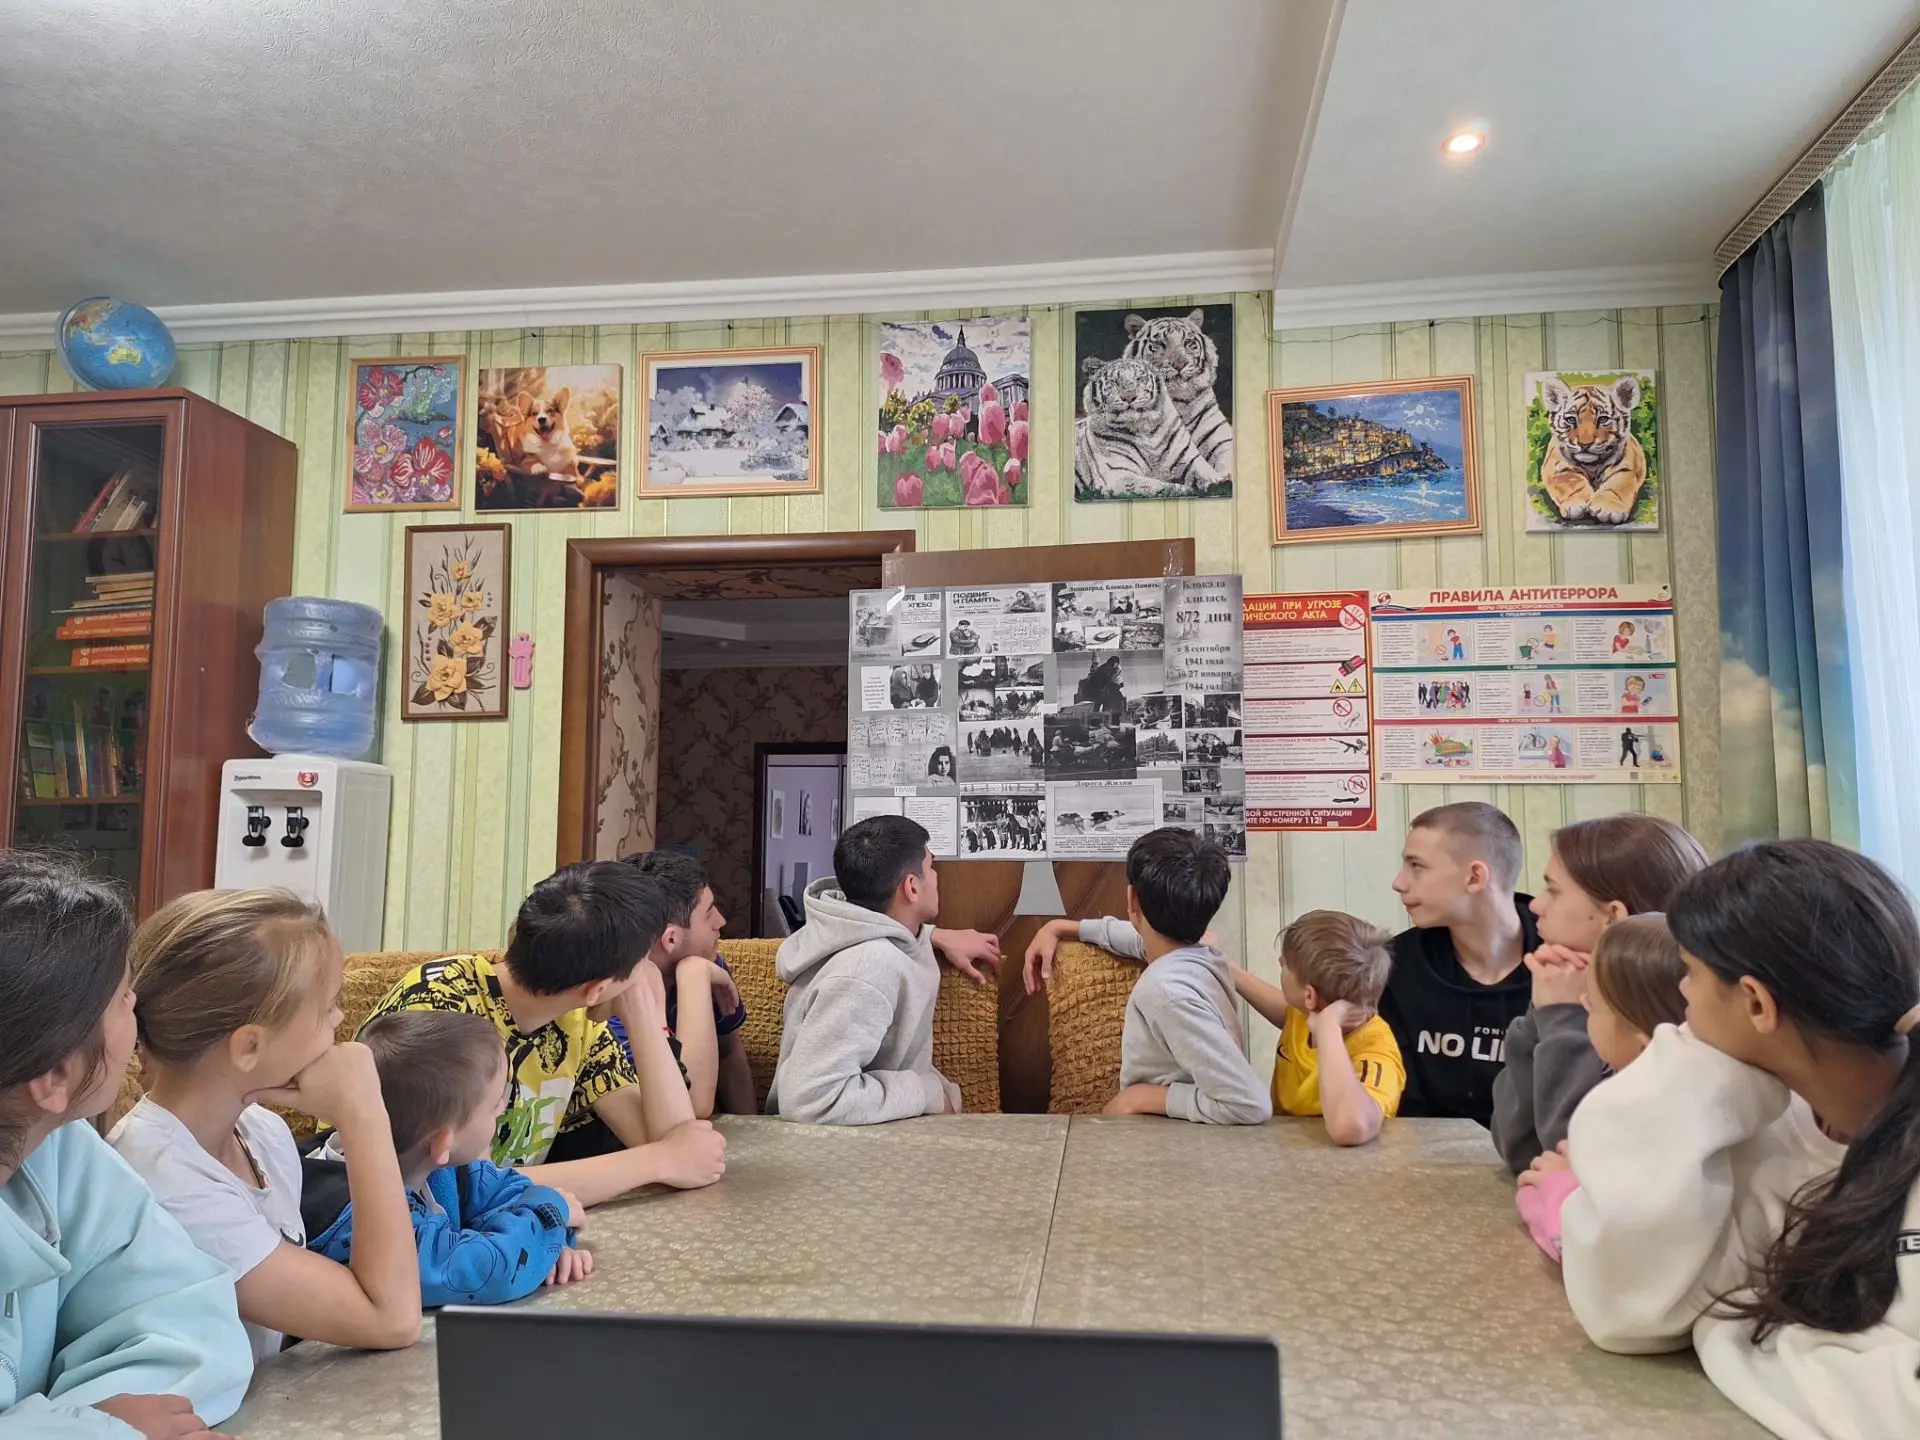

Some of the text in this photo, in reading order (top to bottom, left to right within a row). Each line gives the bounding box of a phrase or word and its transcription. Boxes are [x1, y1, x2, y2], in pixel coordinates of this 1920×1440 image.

[1429, 587, 1619, 604] ПРАВИЛА АНТИТЕРРОРА
[1243, 600, 1342, 612] ДАЦИИ ПРИ УГРОЗЕ
[1204, 612, 1233, 624] дня
[1243, 611, 1328, 621] ТИЧЕСКОГО АКТА
[1246, 808, 1353, 818] БОЙ ЭКСТРЕННОЙ СИТУАЦИИ
[1272, 817, 1302, 825] НОМЕРУ
[1304, 816, 1323, 825] 112!
[1417, 1030, 1465, 1058] NO
